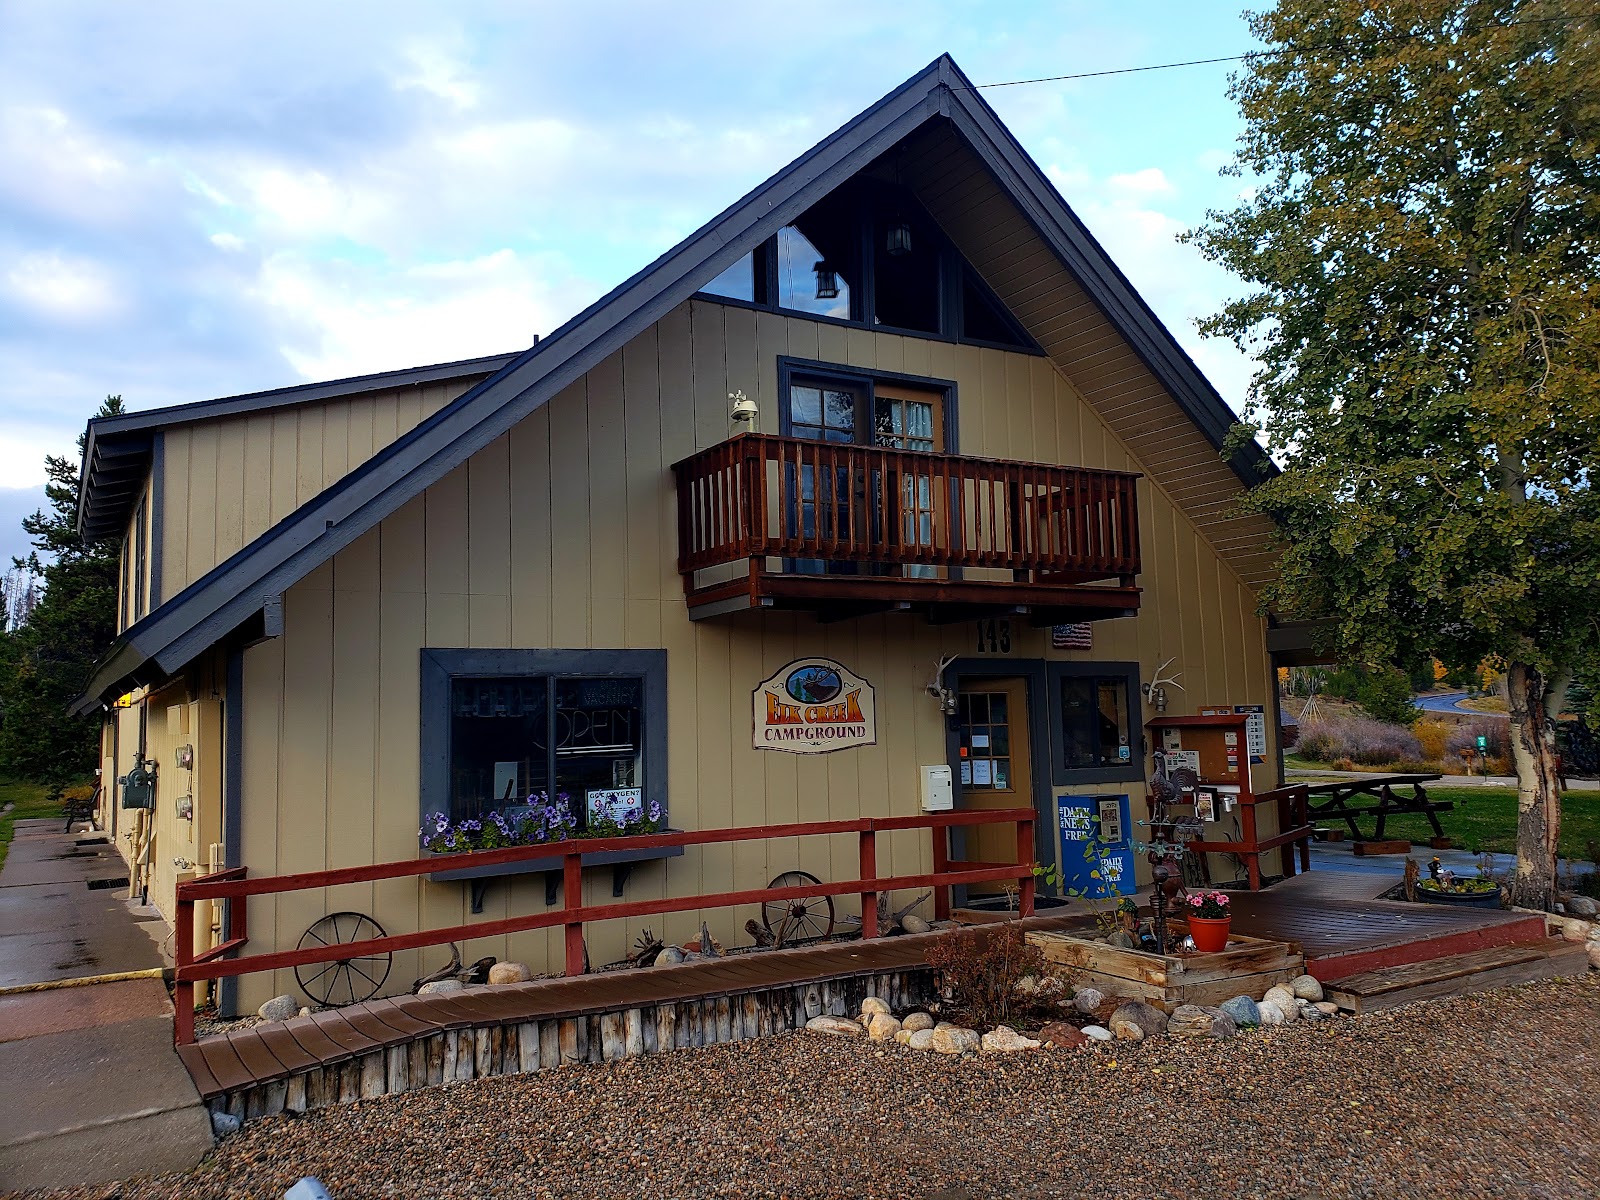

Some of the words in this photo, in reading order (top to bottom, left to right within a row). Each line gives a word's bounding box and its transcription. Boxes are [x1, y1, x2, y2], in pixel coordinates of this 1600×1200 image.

[976, 620, 1011, 654] 143
[765, 690, 803, 725] ELK
[804, 688, 865, 724] CREEK
[532, 709, 632, 749] OPEN
[764, 726, 866, 741] CAMPGROUND
[1063, 807, 1090, 818] DAILY
[1103, 857, 1123, 866] DAILY
